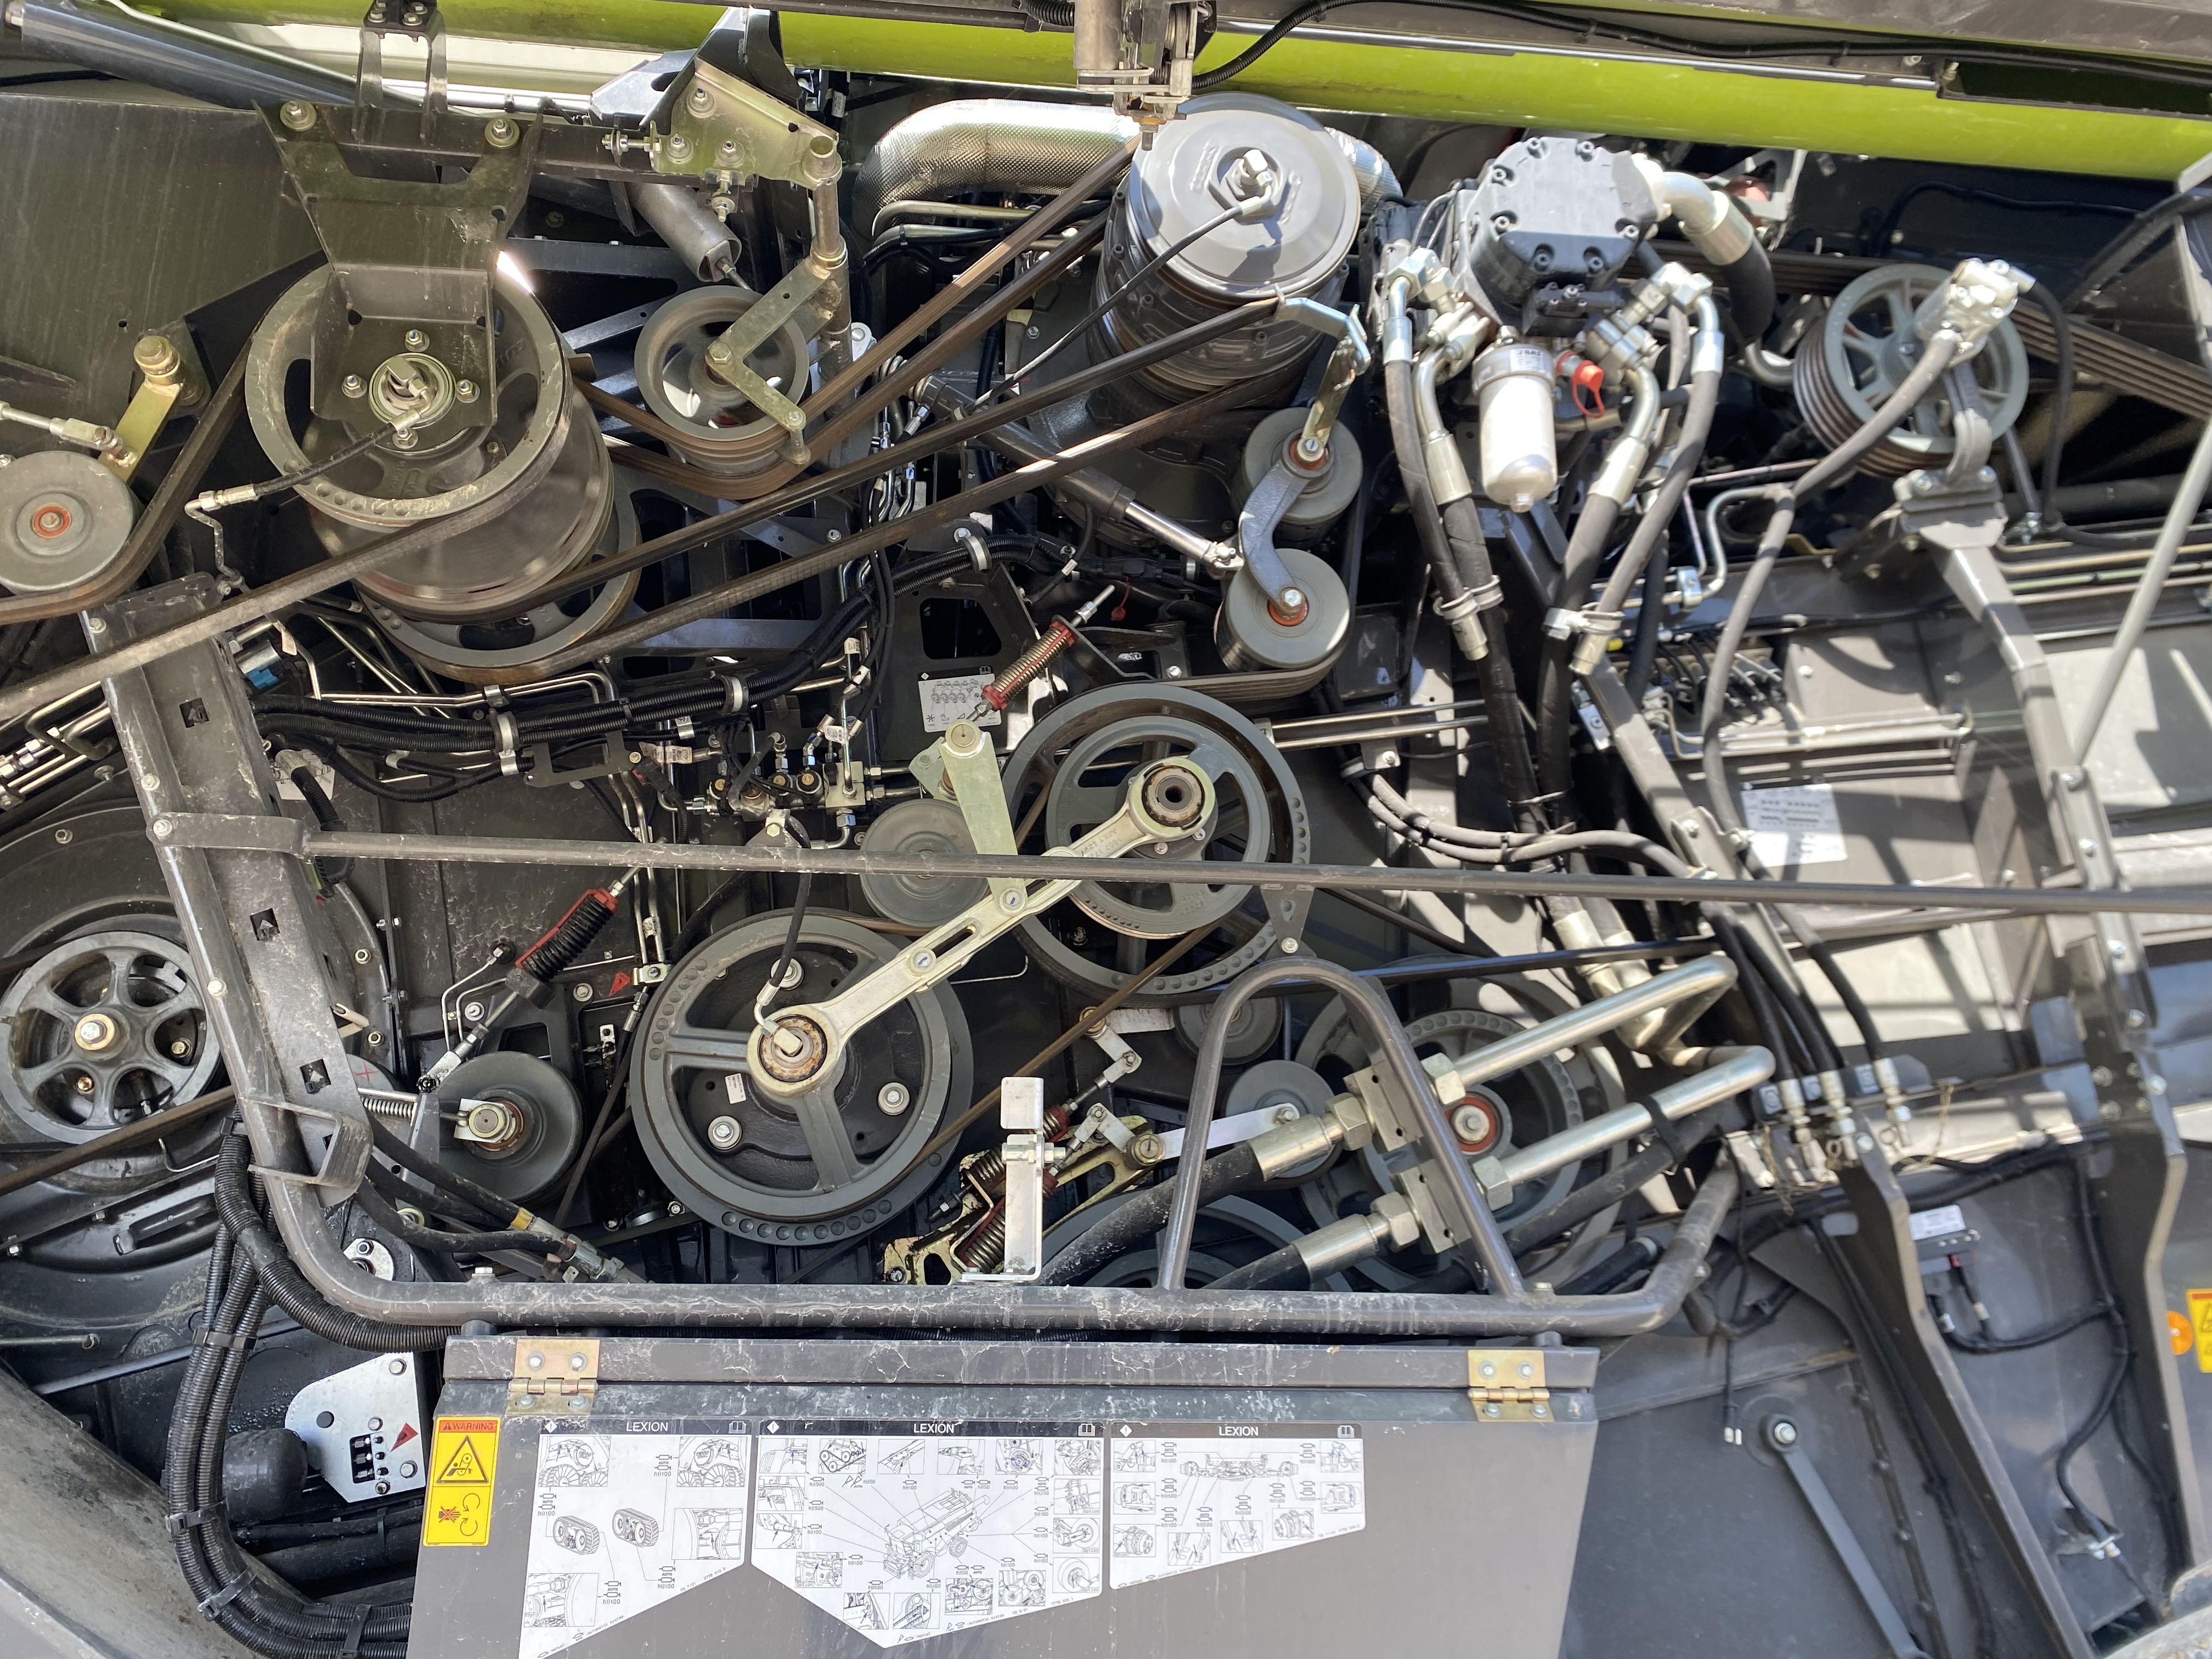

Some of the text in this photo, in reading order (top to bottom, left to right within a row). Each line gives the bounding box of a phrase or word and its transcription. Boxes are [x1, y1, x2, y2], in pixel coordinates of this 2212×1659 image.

[626, 1422, 668, 1432] LEXION
[913, 1423, 955, 1434] LEXION
[1218, 1426, 1259, 1436] LEXION
